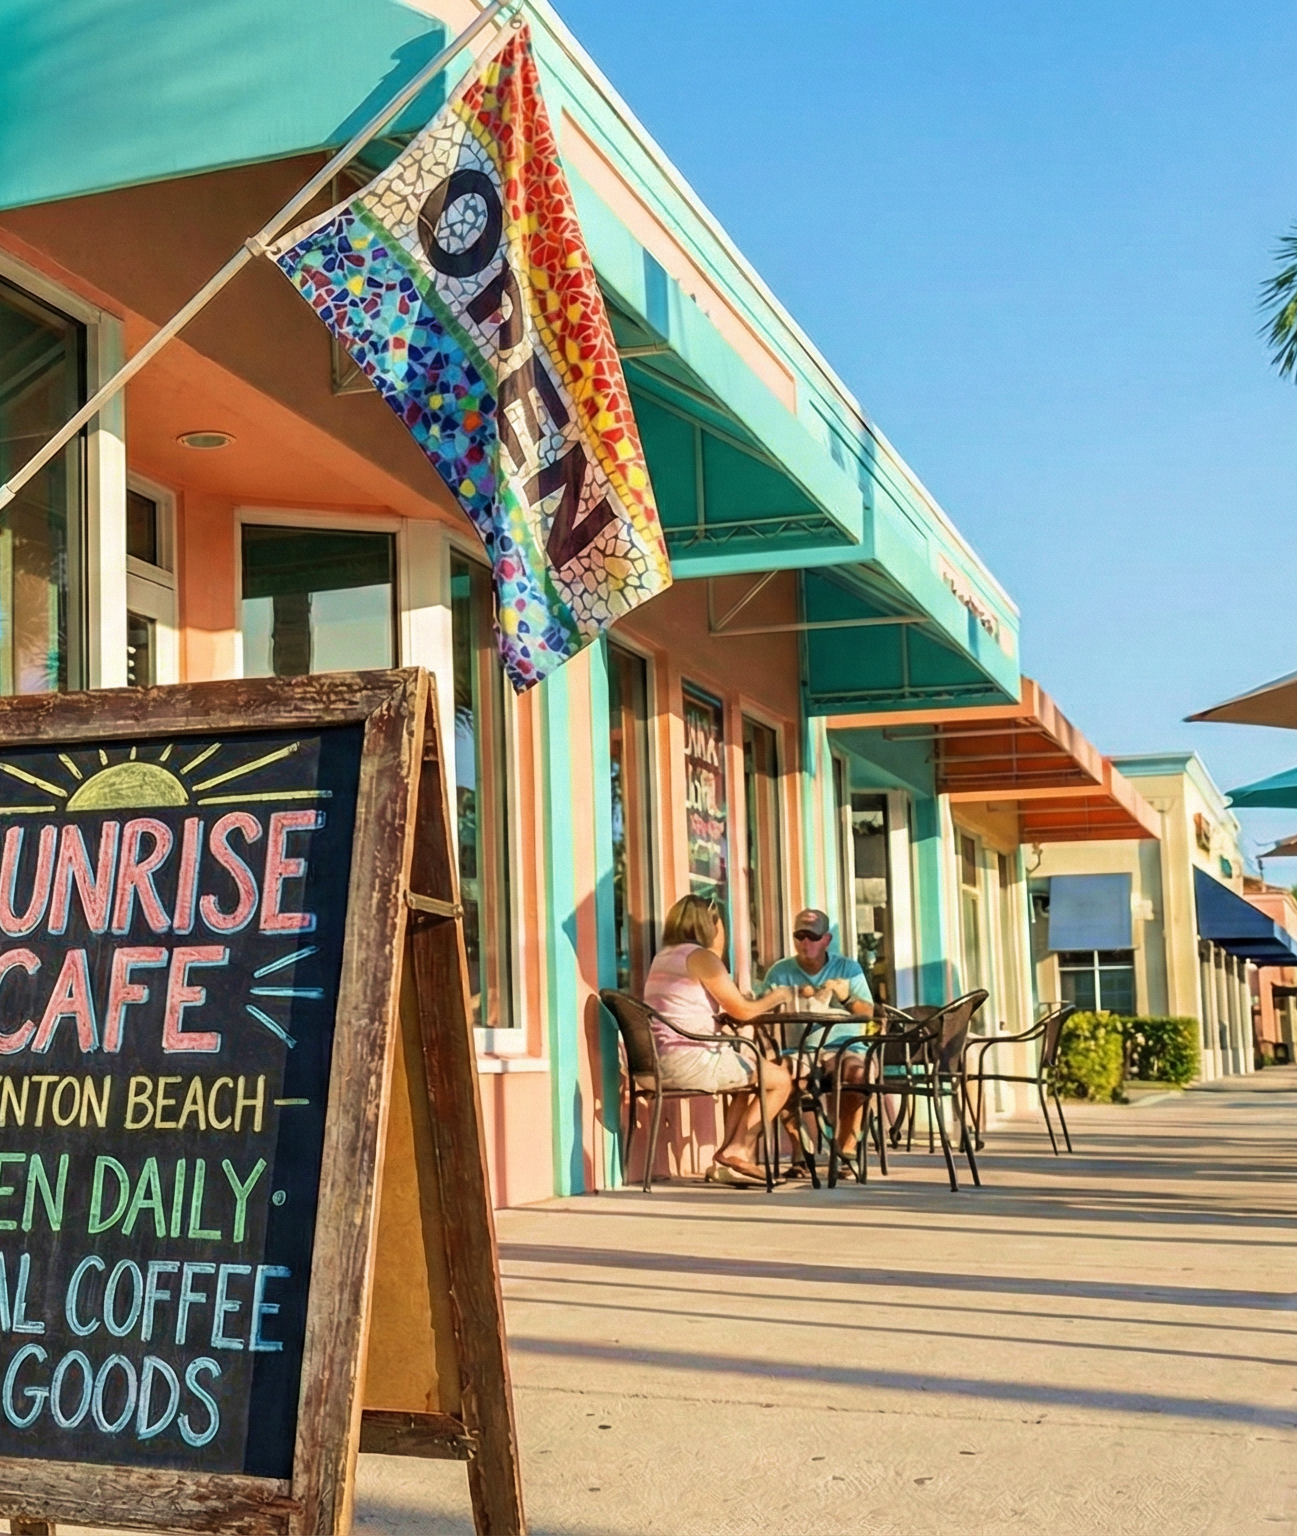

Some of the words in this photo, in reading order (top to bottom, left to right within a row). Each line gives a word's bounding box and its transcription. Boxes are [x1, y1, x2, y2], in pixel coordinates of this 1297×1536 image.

[418, 169, 619, 573] OPEN
[124, 1075, 266, 1132] BEACH
[88, 1155, 267, 1243] DAILY
[65, 1256, 292, 1352] COFFEE
[3, 1343, 221, 1447] GOODS
